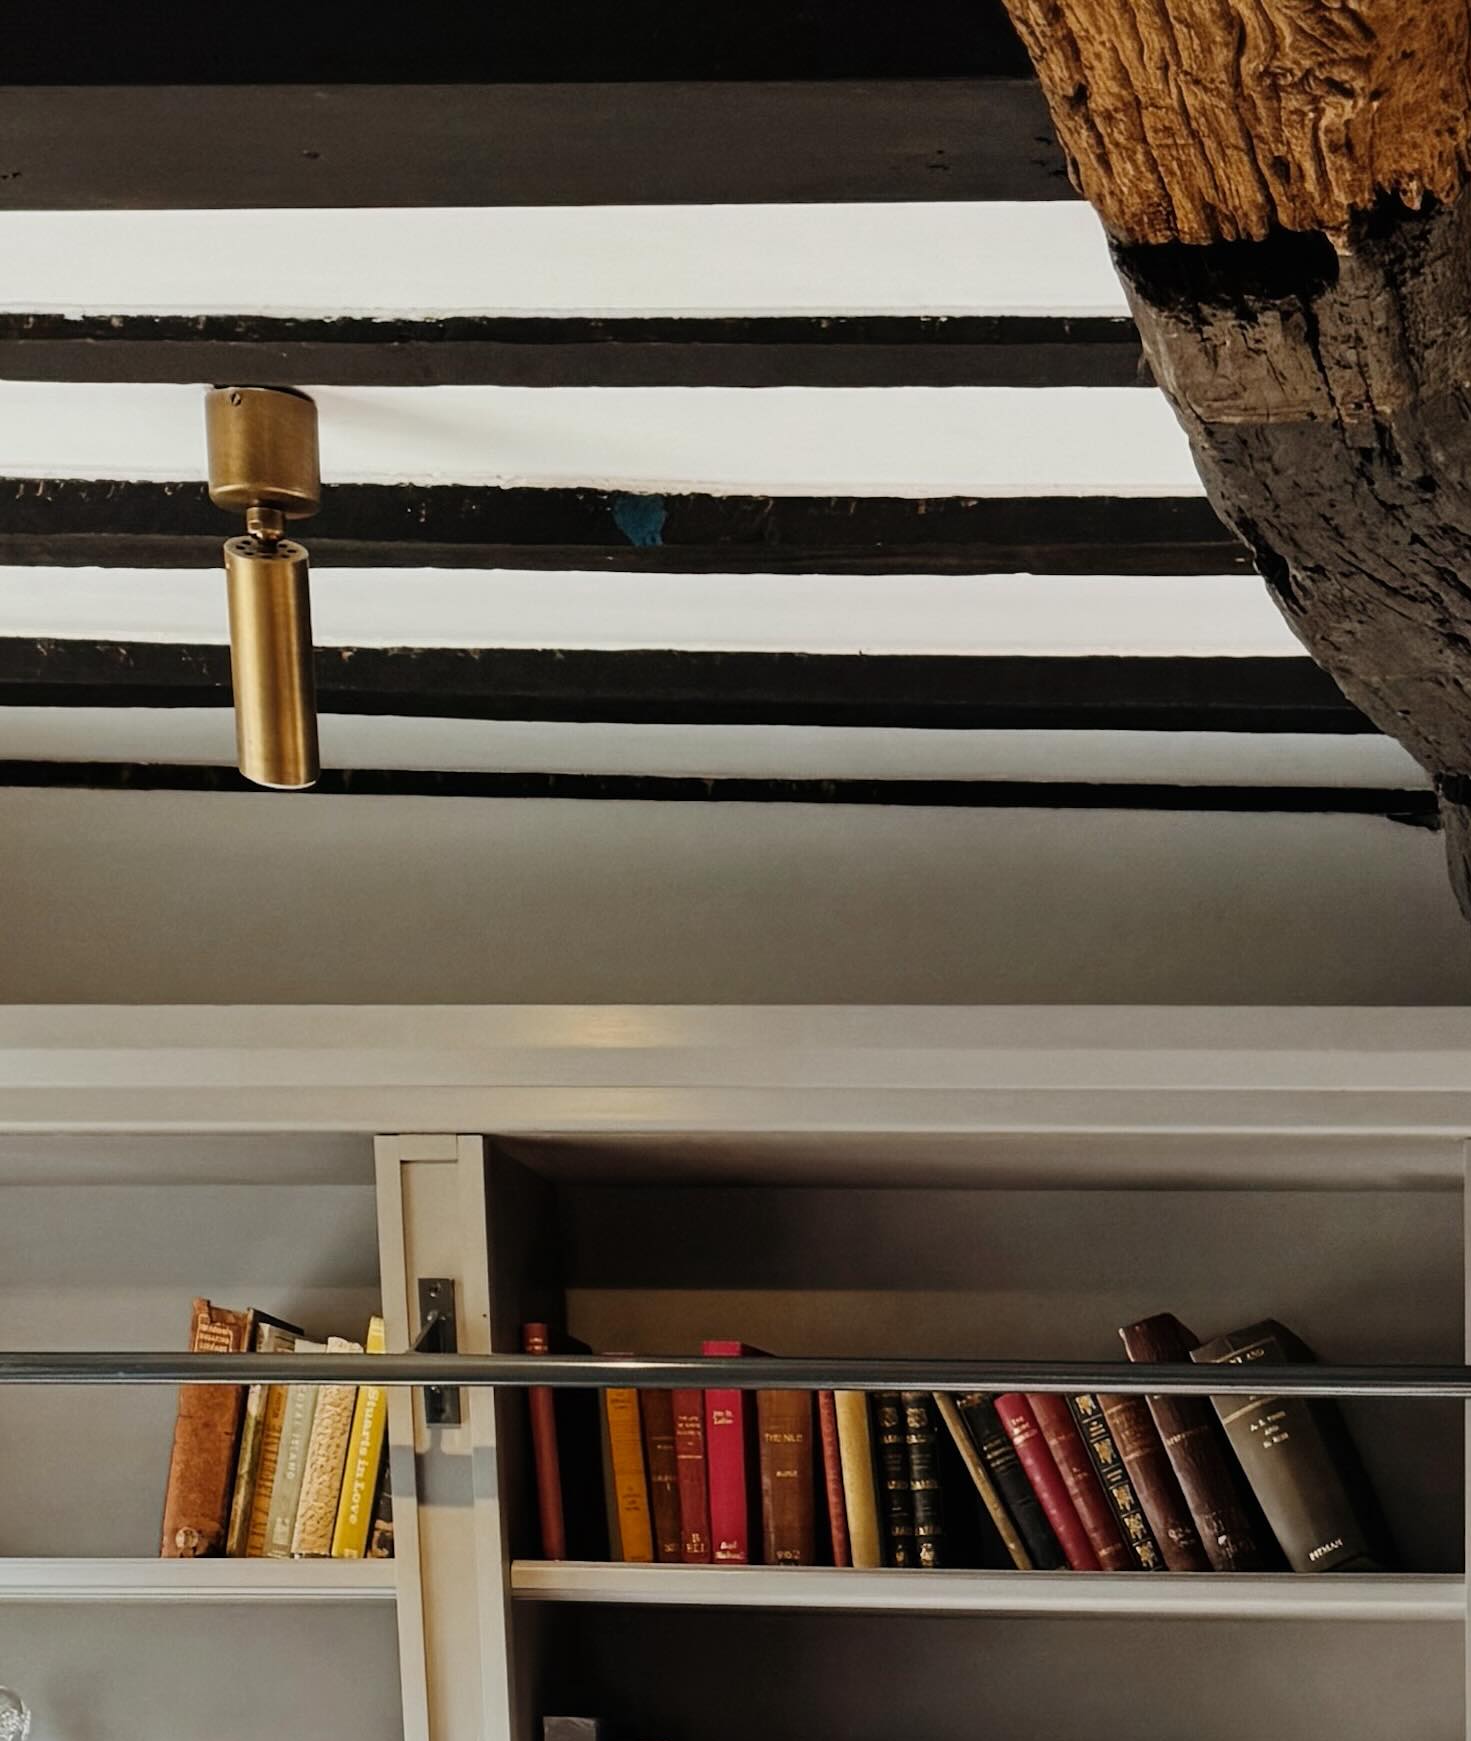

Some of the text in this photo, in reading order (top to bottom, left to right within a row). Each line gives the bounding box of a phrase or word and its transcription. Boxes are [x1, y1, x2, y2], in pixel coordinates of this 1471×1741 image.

[349, 1387, 380, 1525] Stuarts in Love
